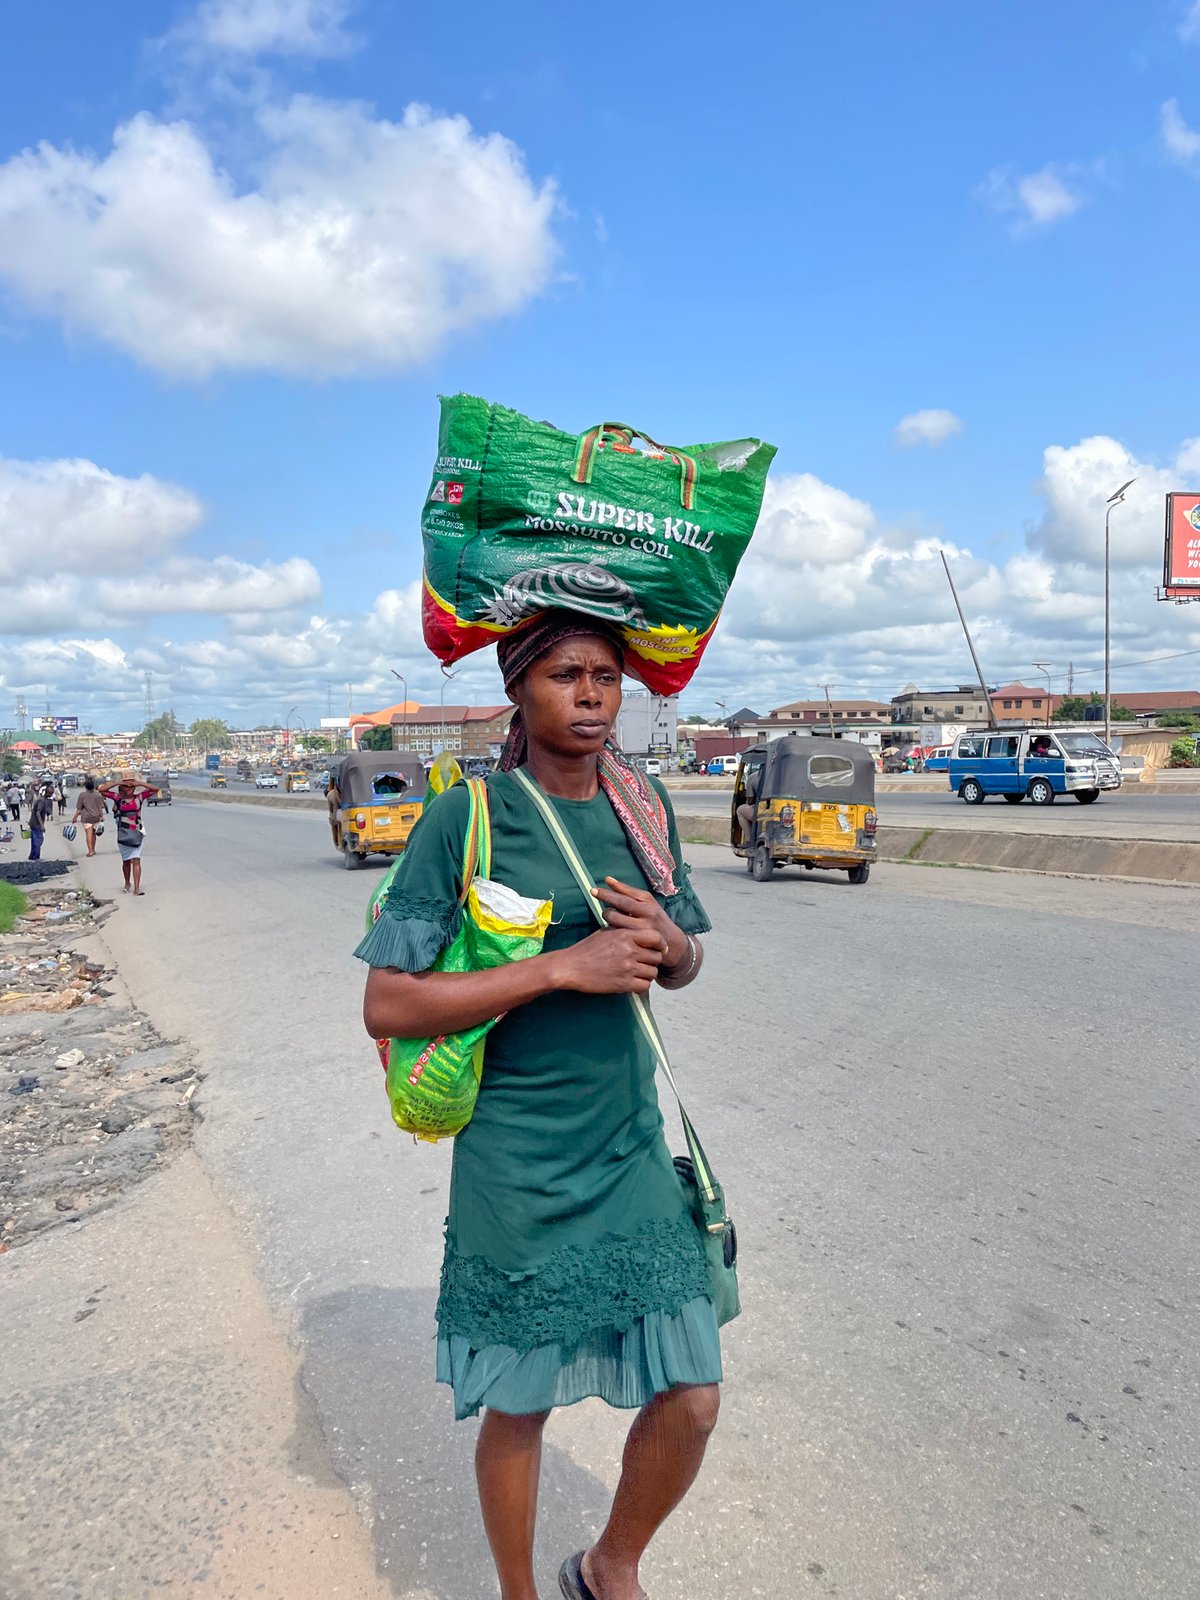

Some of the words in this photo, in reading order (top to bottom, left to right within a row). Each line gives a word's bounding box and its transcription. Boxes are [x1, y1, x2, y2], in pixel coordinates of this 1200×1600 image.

[458, 457, 482, 471] KILL
[554, 491, 657, 535] SUPER
[662, 516, 715, 553] KILL
[524, 514, 626, 546] MOSQUITO
[629, 537, 674, 560] COIL
[630, 637, 690, 654] MOSQUITO
[655, 636, 680, 644] ANTI
